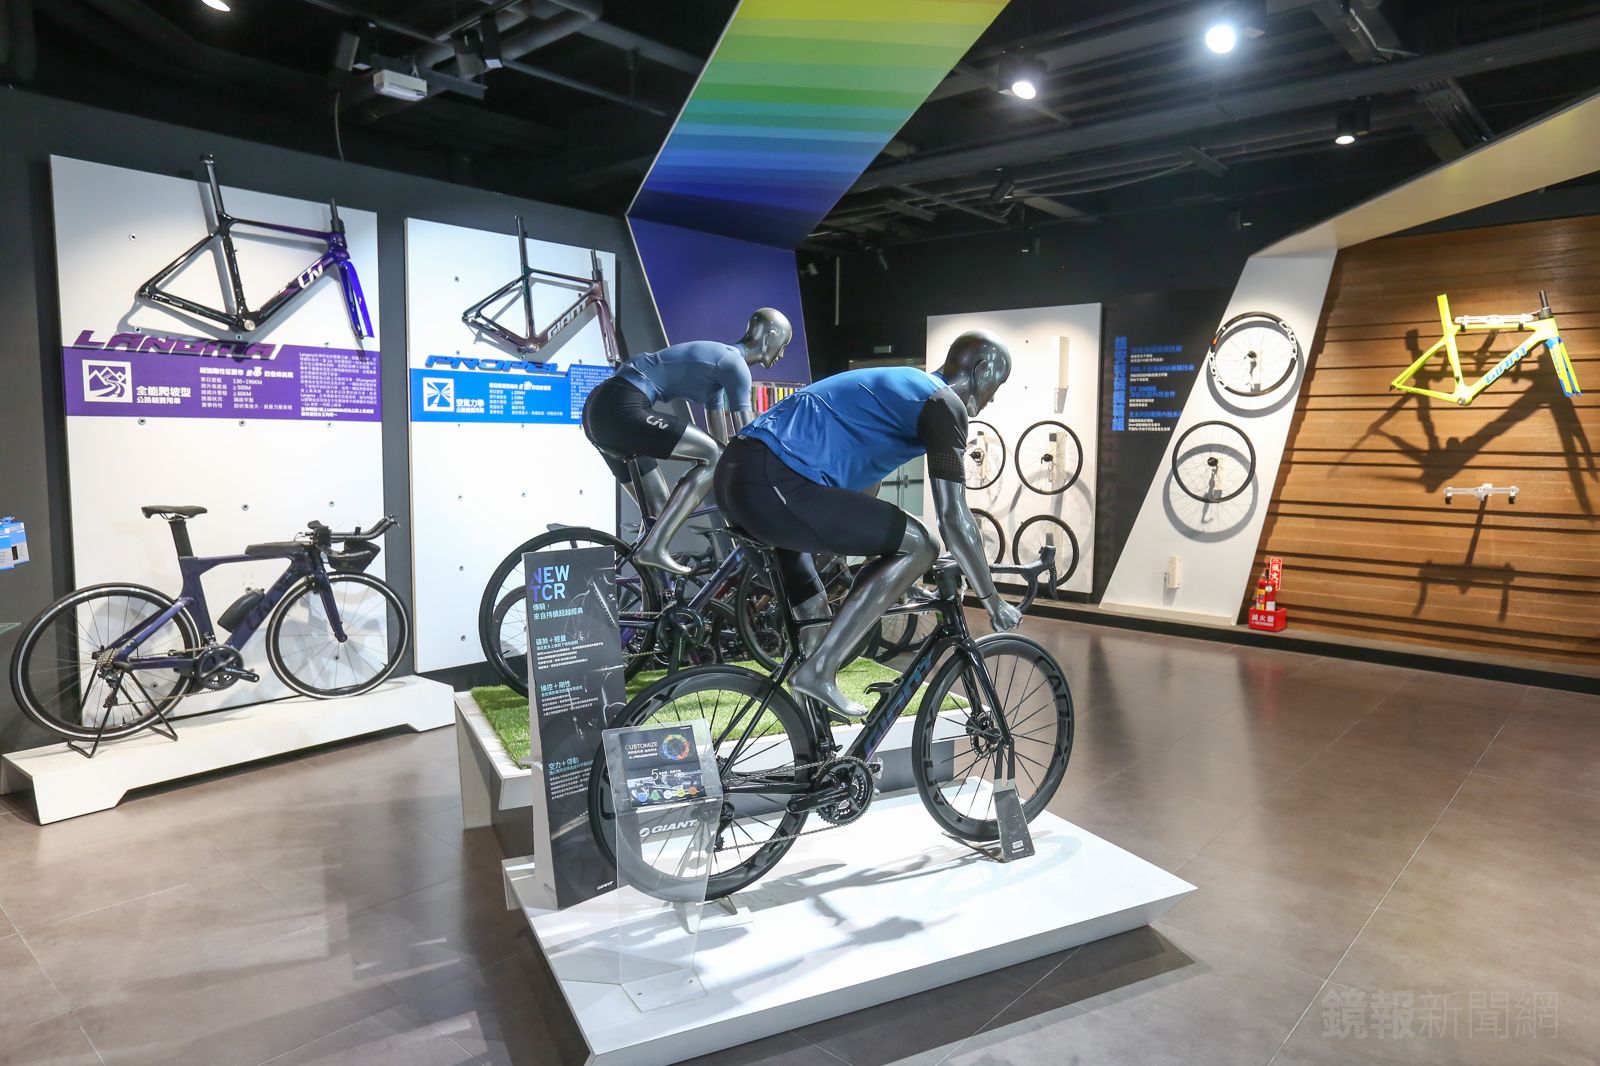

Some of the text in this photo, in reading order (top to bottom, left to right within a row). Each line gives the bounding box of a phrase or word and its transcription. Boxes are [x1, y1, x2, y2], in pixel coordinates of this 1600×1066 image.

[548, 296, 589, 341] GIANT
[72, 330, 276, 358] LANGMA
[425, 355, 567, 375] PROPEL
[1486, 345, 1528, 384] GIANT
[136, 385, 191, 398] 全能爬坡型
[646, 415, 669, 430] Liv
[531, 564, 570, 585] NEW
[529, 582, 566, 602] TCR
[651, 768, 659, 781] 5
[651, 819, 697, 834] GIANT
